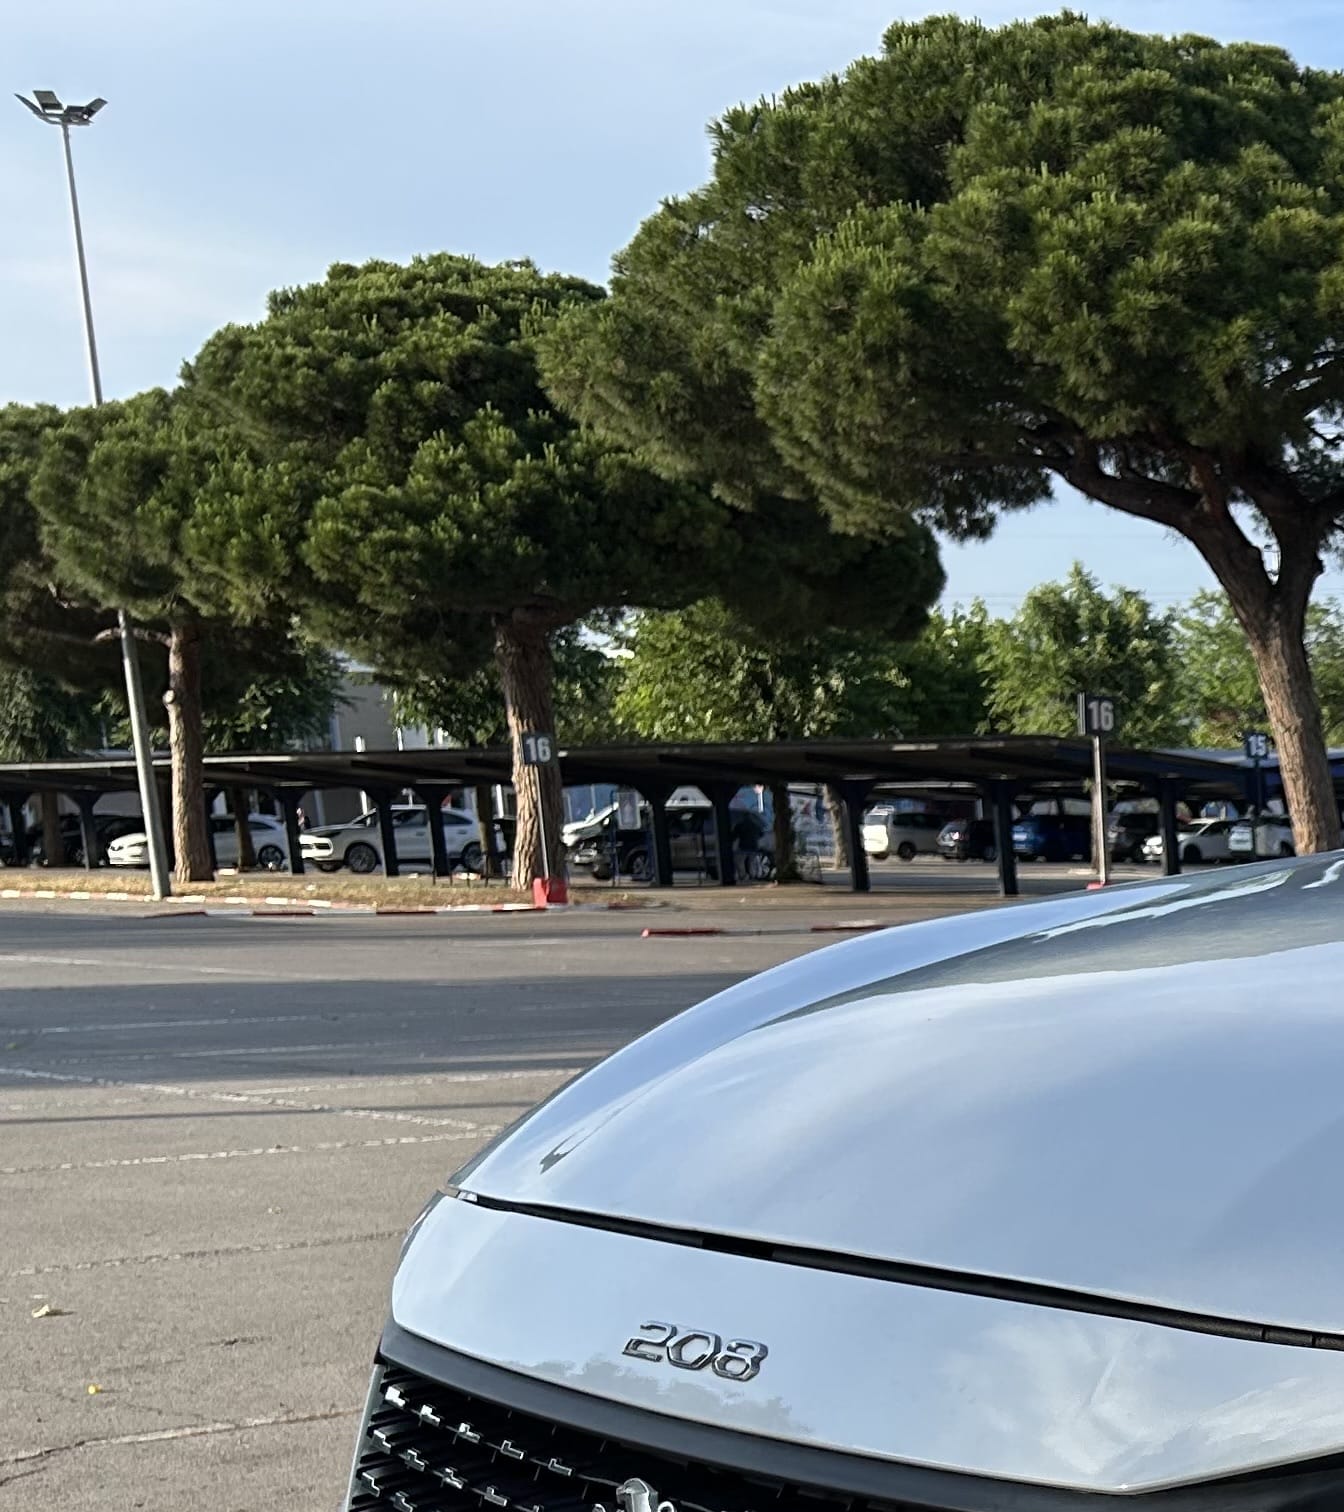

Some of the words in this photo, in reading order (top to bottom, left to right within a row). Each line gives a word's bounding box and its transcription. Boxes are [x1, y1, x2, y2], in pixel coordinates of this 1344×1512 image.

[1087, 700, 1115, 732] 16
[525, 736, 552, 763] 16
[1247, 734, 1267, 757] 15
[621, 1320, 769, 1382] 208
